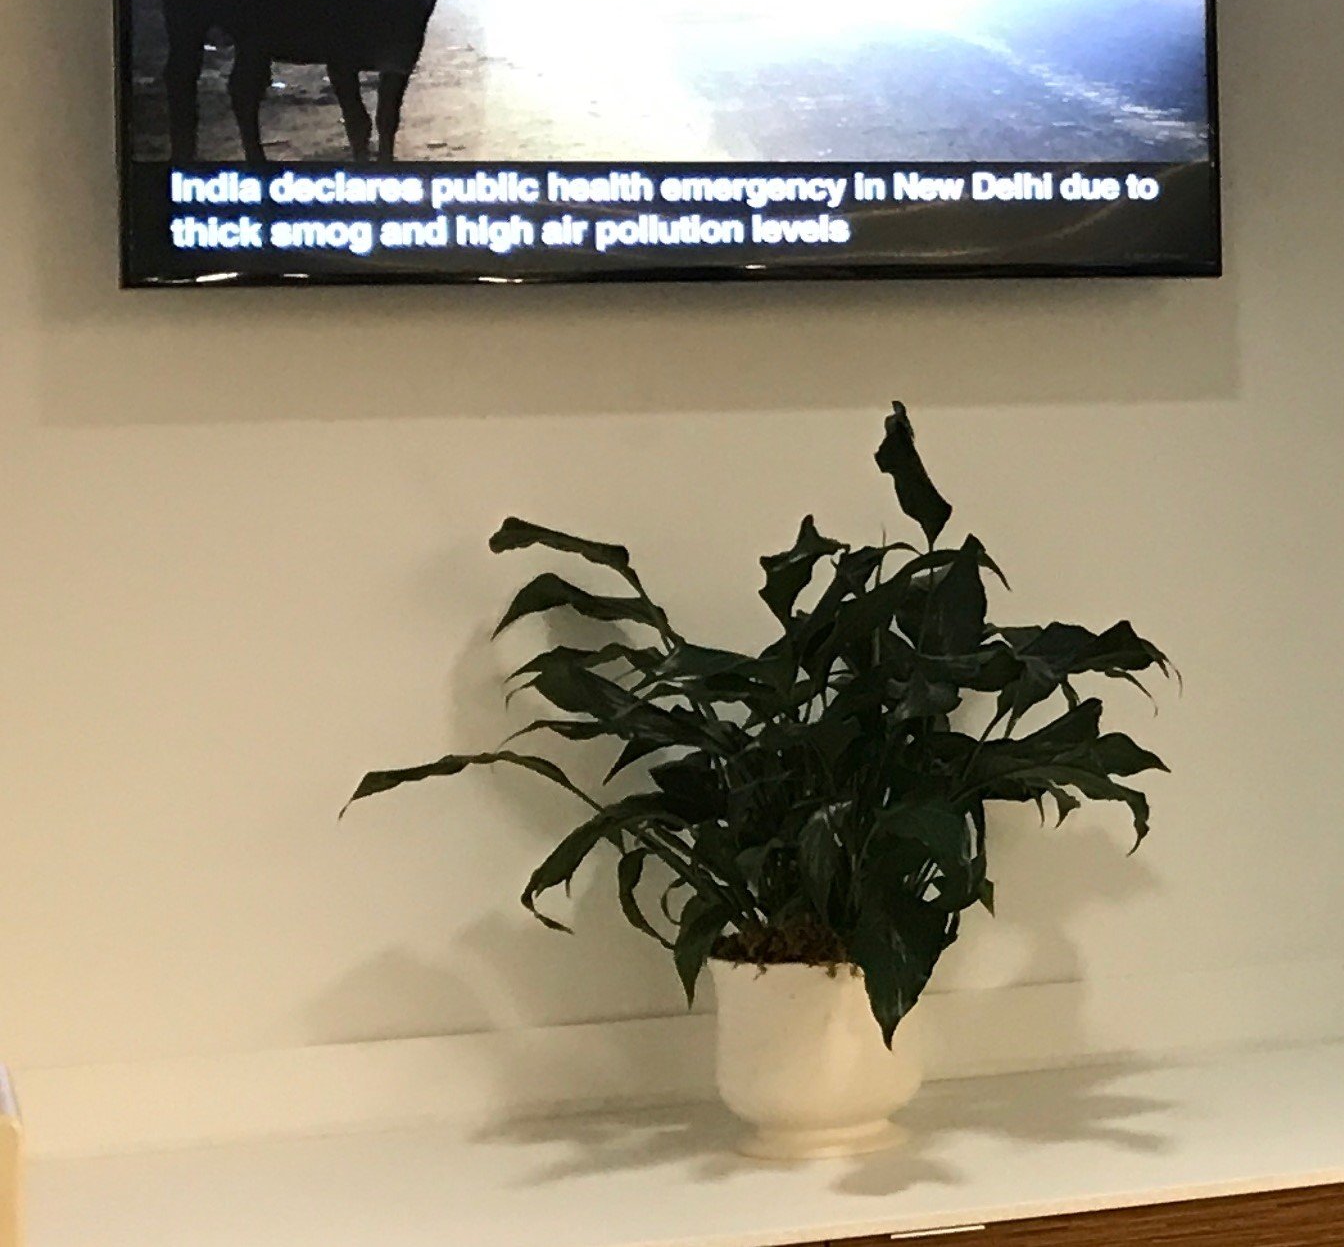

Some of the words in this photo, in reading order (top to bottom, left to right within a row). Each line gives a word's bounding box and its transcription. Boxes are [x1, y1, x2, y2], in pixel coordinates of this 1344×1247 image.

[170, 170, 263, 204] India
[268, 170, 426, 205] declares
[429, 170, 541, 211] public
[546, 170, 656, 204] health
[658, 176, 849, 210] emergency
[853, 170, 887, 202] in
[891, 170, 966, 203] New
[970, 170, 1054, 202] Delhi
[1058, 171, 1122, 202] due
[1124, 172, 1161, 201] to
[169, 215, 264, 249] thick
[269, 220, 374, 256] smog
[378, 213, 450, 248] and
[454, 213, 536, 255] high
[540, 213, 590, 247] air
[594, 212, 746, 253] pollution
[750, 212, 852, 245] levels
